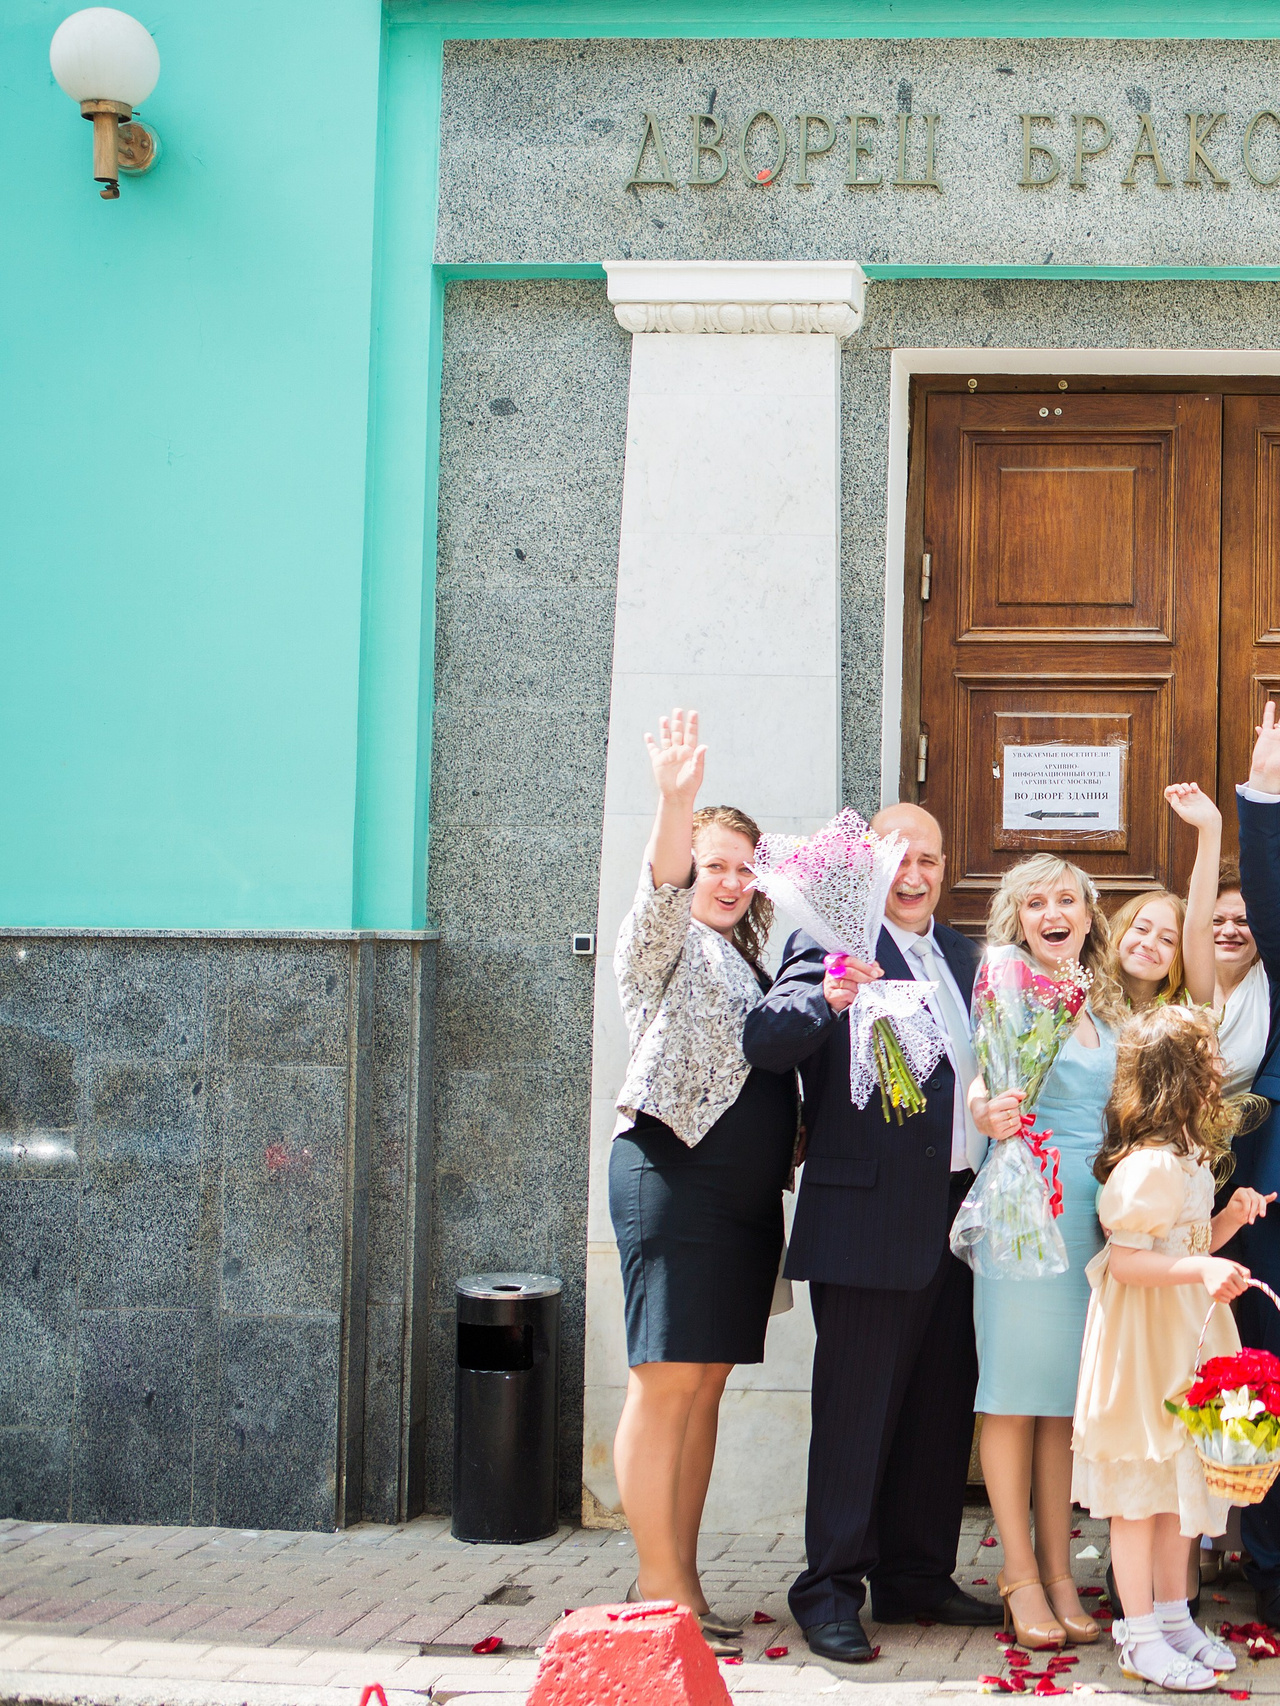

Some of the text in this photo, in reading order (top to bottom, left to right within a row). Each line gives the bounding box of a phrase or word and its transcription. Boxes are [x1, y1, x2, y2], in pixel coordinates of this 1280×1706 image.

[624, 110, 944, 194] ДВОРЕЦ
[1030, 792, 1064, 802] ДВОРЕ
[1066, 792, 1109, 802] ЗДАНИЯ
